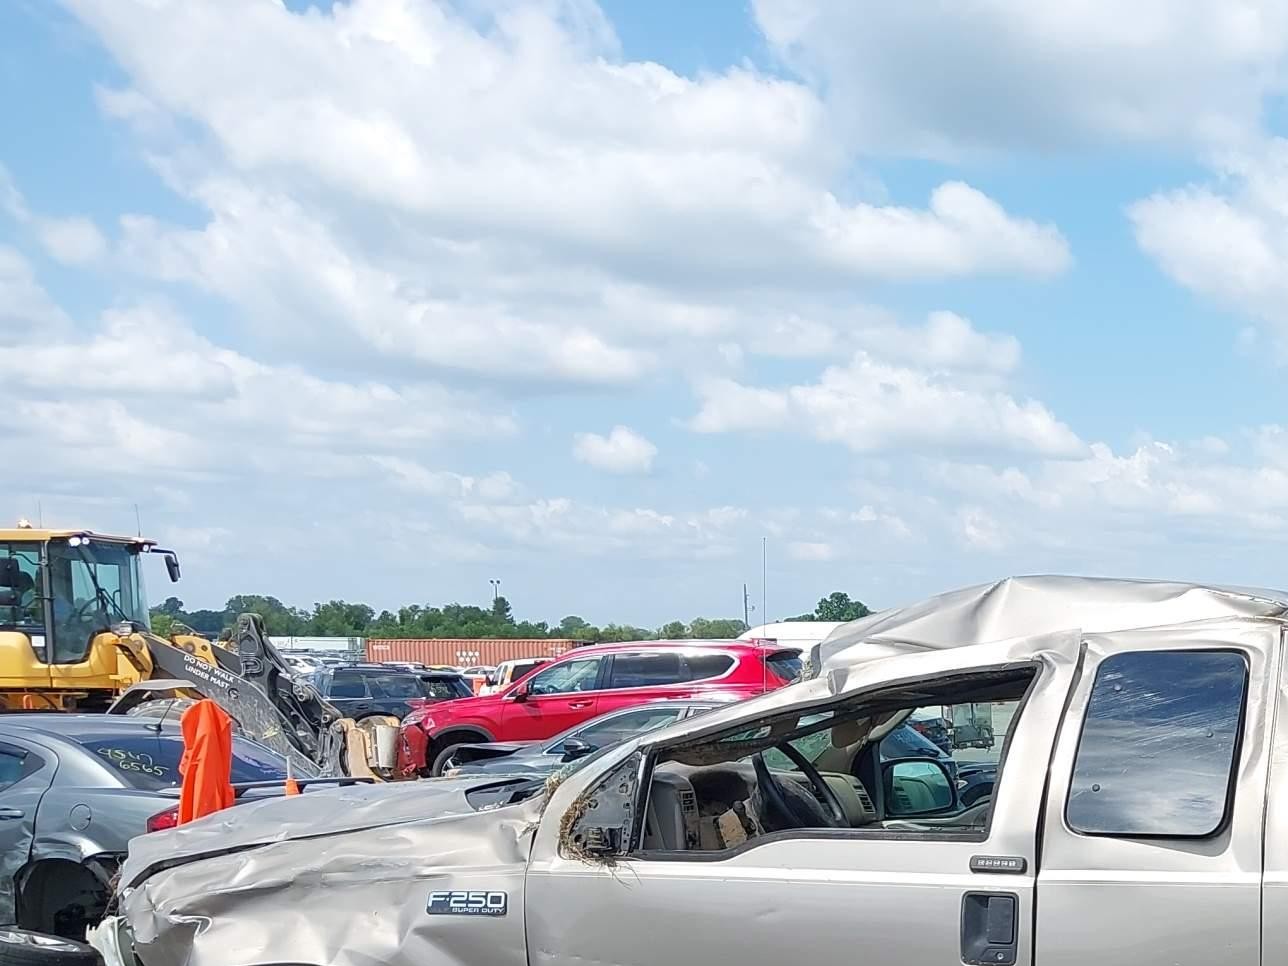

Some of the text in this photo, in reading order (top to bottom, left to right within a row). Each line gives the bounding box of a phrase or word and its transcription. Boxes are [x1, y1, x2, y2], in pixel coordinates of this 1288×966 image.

[184, 654, 235, 684] DO NOT WALK
[185, 664, 230, 689] UNDER MAST
[120, 760, 170, 776] 6565
